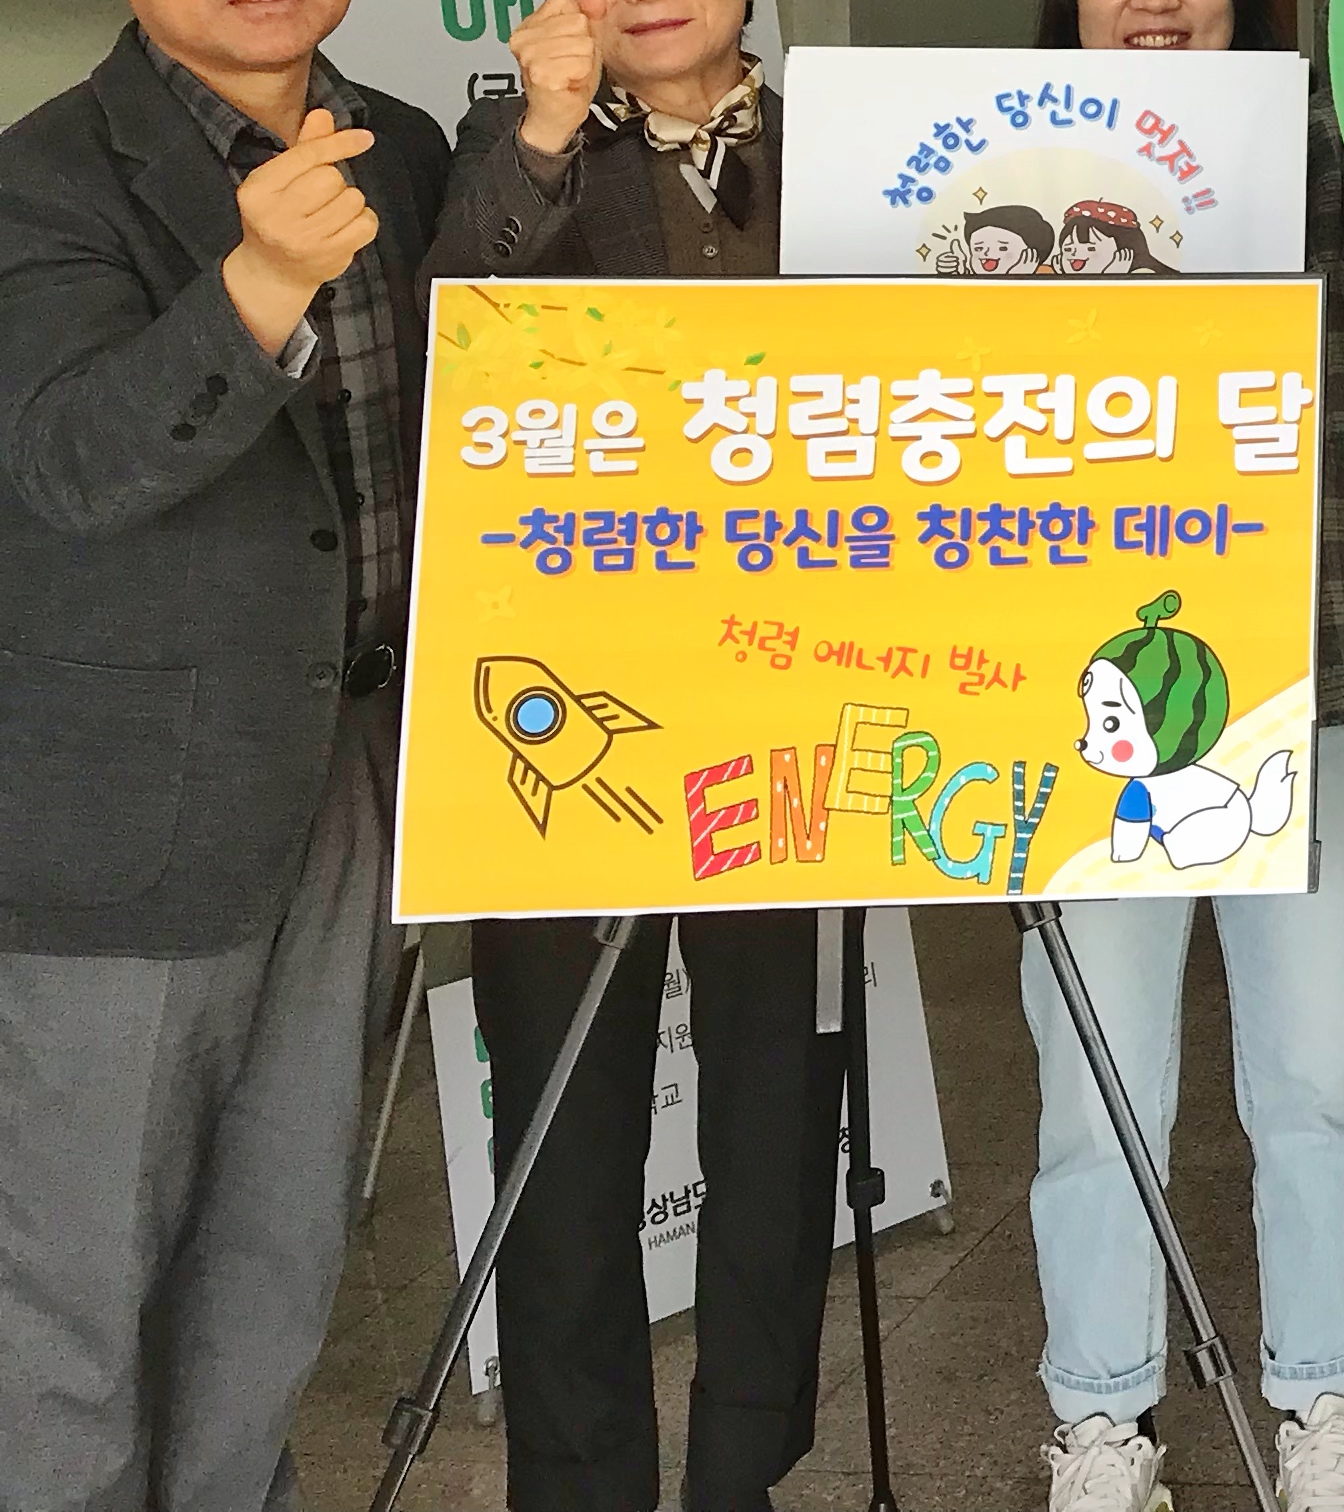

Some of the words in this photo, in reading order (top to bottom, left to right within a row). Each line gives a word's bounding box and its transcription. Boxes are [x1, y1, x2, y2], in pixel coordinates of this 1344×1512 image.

[882, 115, 989, 210] 청렴한
[995, 81, 1120, 130] 당신이
[460, 400, 645, 476] 3월은
[681, 368, 1180, 486] 청렴충전의
[1218, 371, 1313, 478] 달
[725, 505, 894, 572] 당신을
[917, 503, 1095, 569] 칭찬한
[718, 614, 800, 672] 청렴
[814, 640, 930, 681] 에너지
[949, 645, 1028, 696] 발사
[684, 701, 1059, 895] ENERGY
